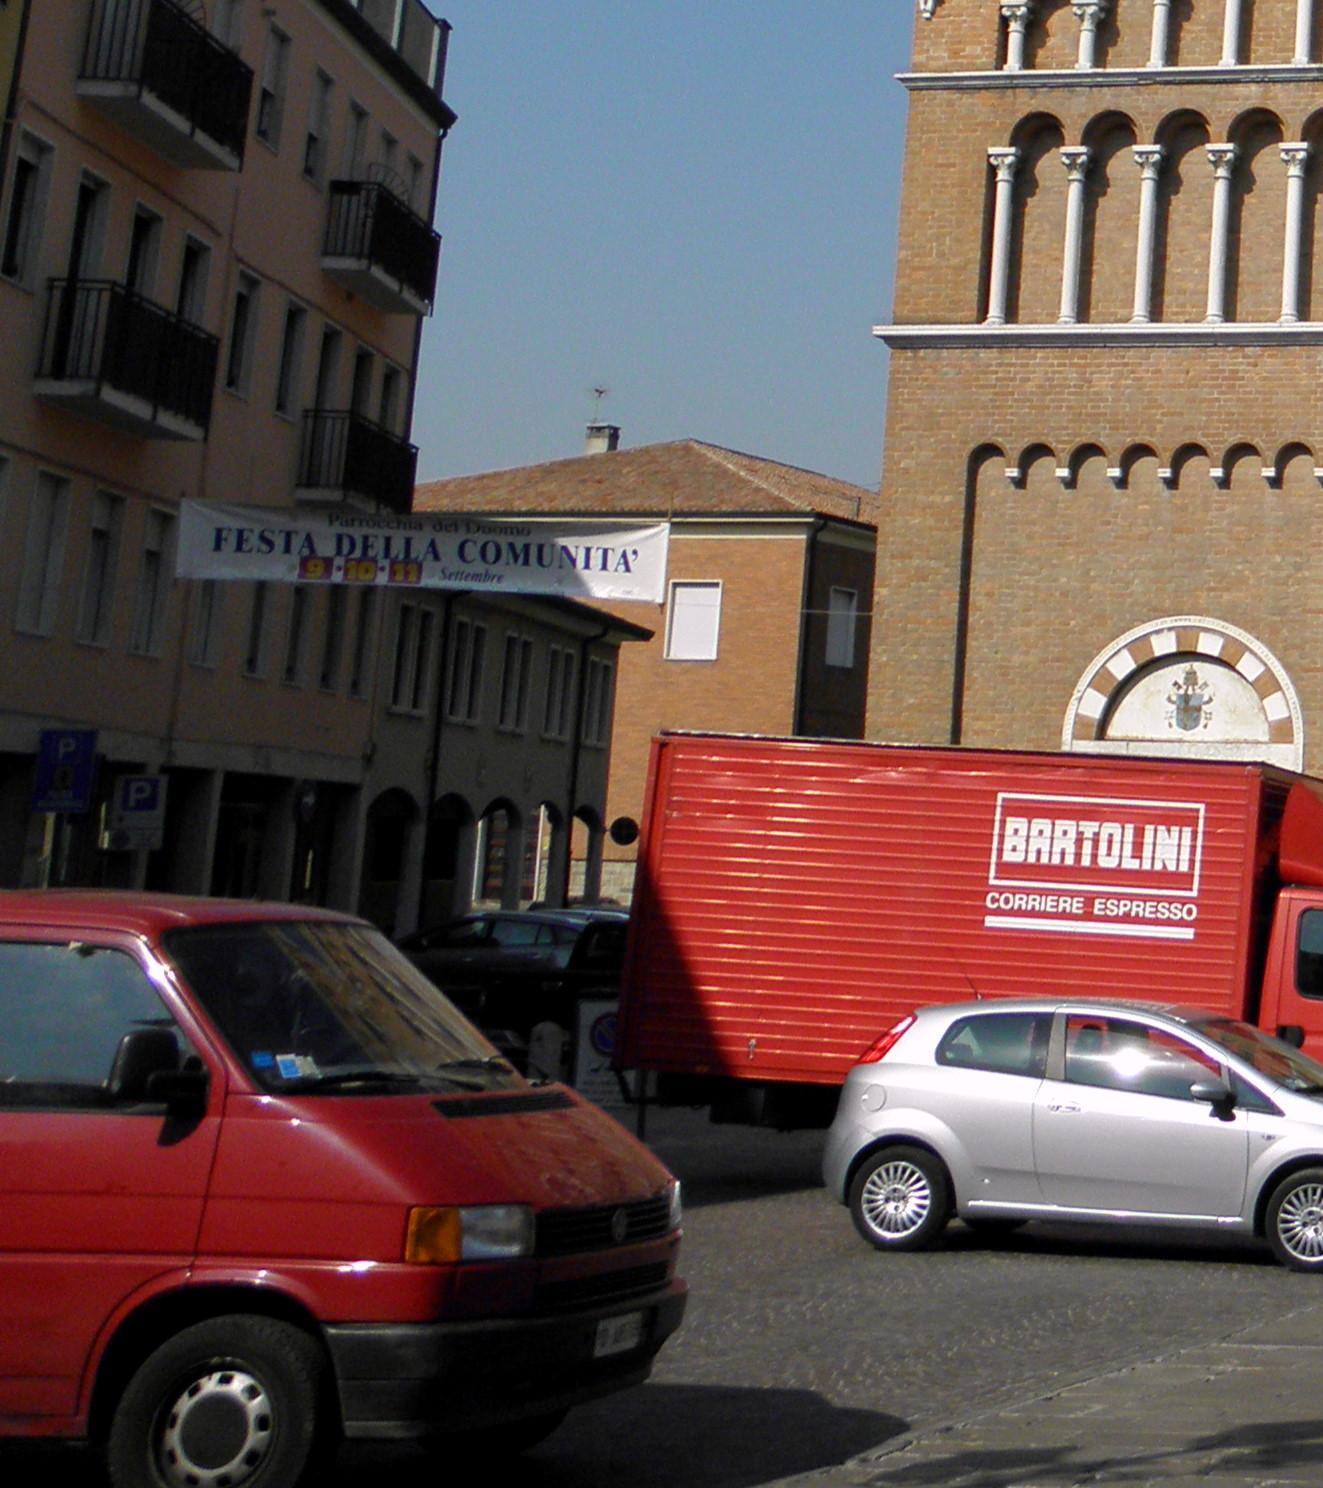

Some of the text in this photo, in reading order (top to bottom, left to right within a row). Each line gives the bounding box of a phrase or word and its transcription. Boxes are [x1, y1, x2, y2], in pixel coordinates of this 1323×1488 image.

[212, 527, 317, 555] FESTA
[335, 533, 441, 561] DELLA
[440, 567, 504, 585] Settembre
[58, 737, 77, 760] P
[128, 781, 152, 808] P
[1002, 817, 1193, 872] BARTOLINI
[985, 891, 1198, 921] CORRIERE ESPRESSO
